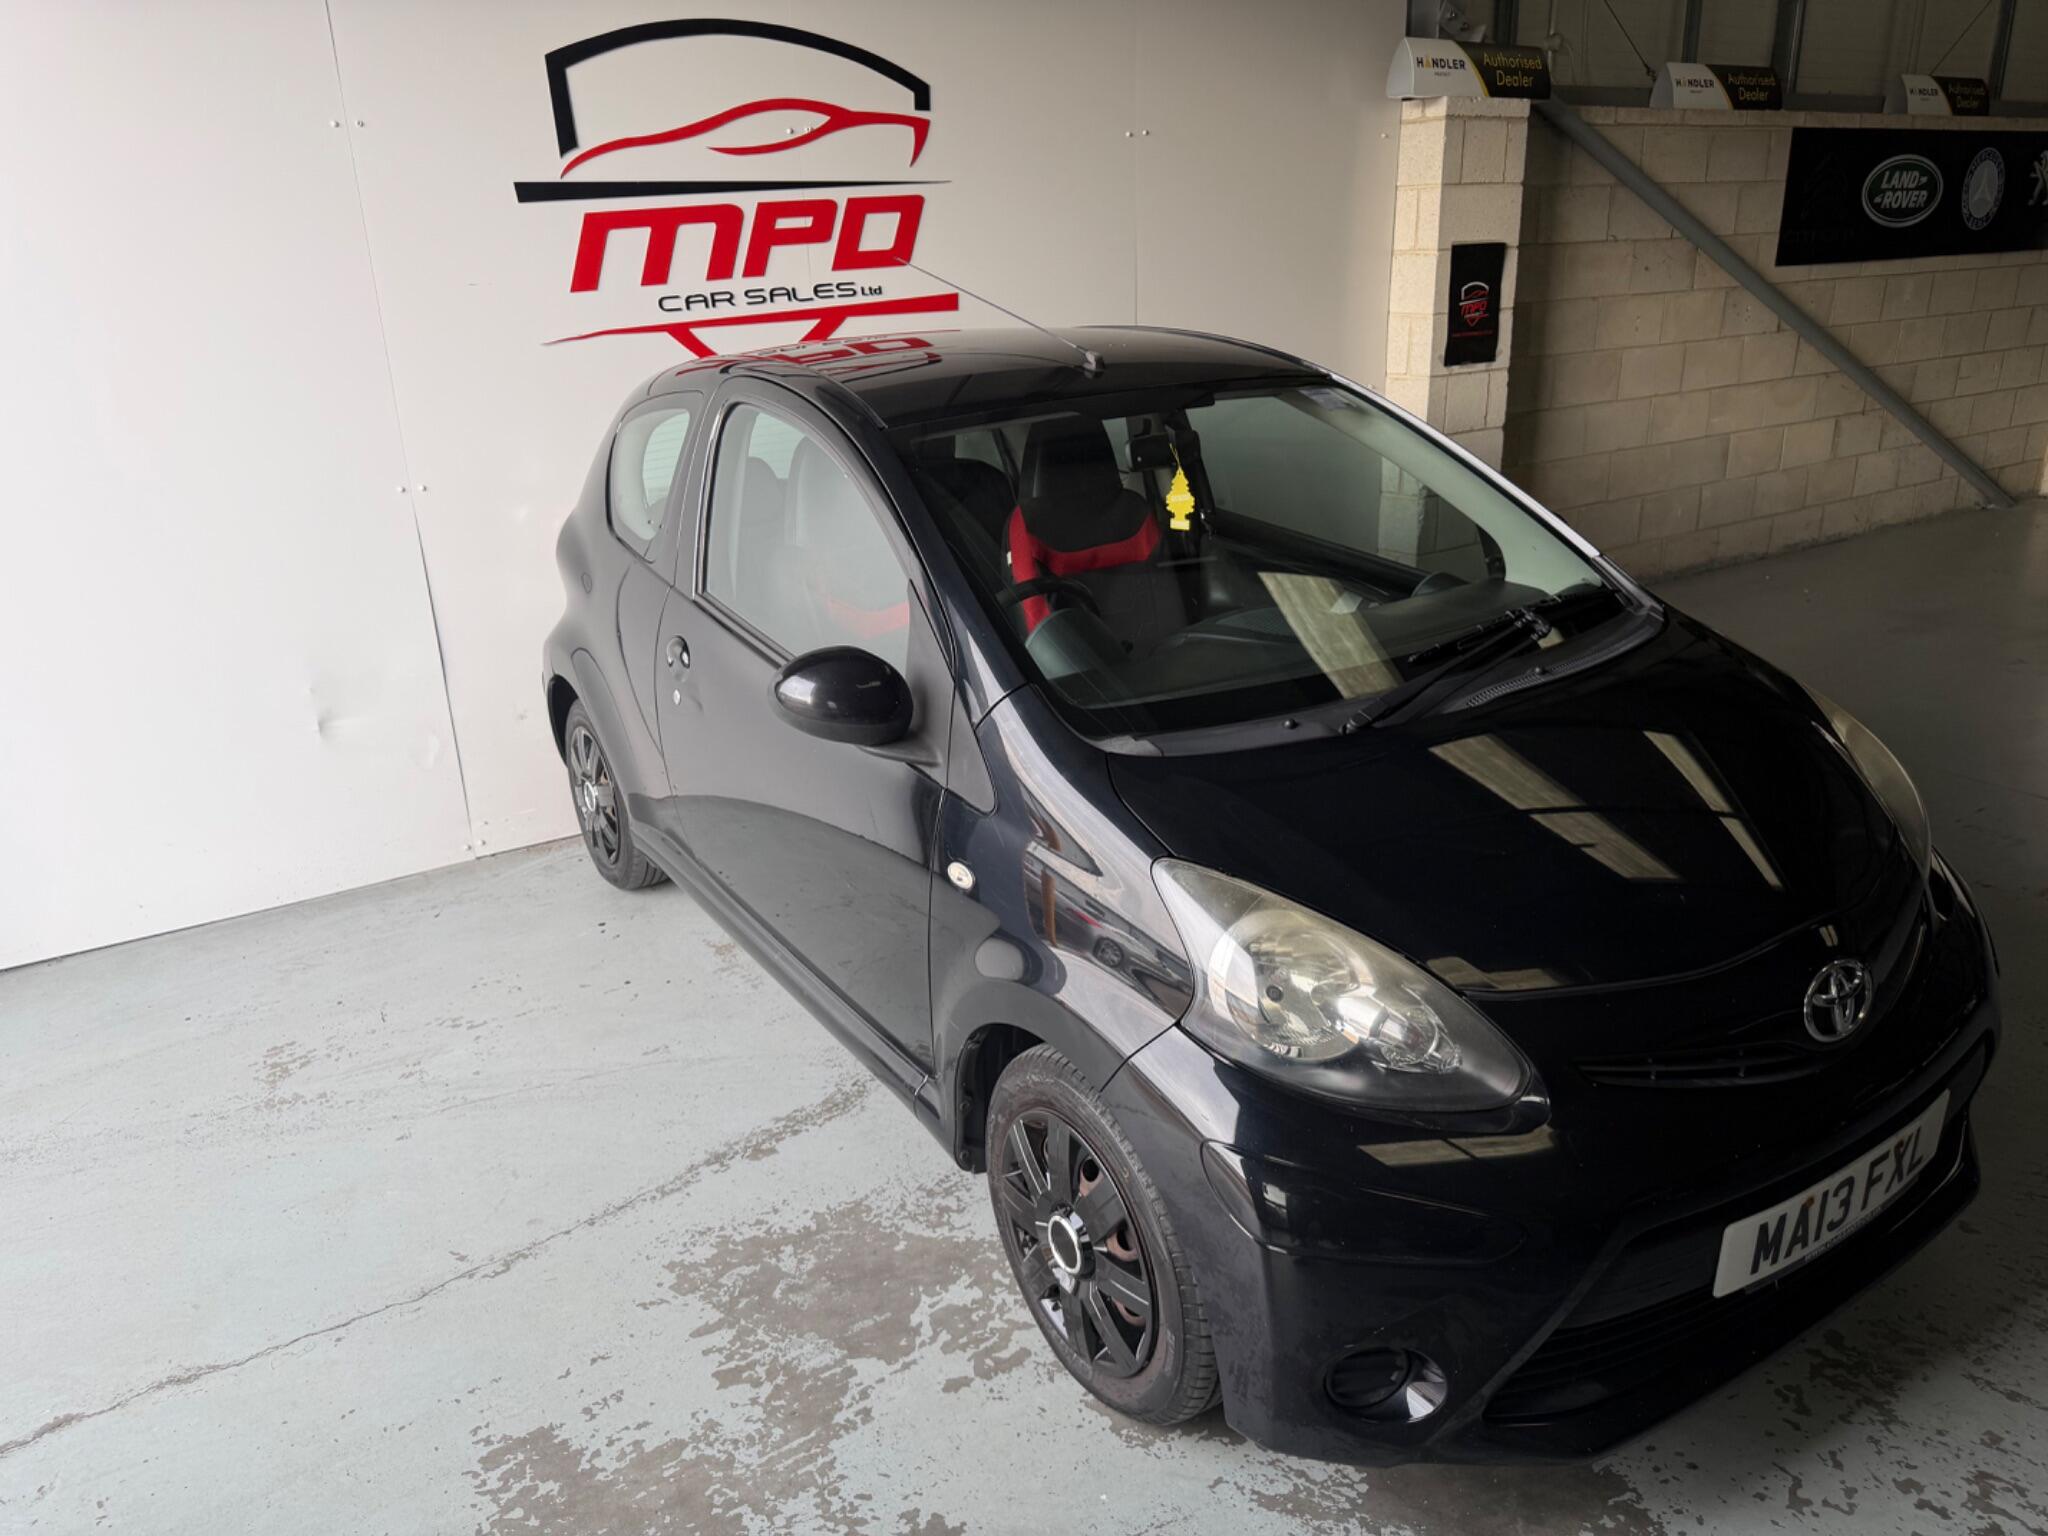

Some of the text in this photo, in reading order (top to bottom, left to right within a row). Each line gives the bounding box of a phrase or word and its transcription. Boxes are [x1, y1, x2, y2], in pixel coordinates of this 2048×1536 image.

[1483, 52, 1542, 70] Authorised
[1496, 70, 1534, 87] Dealer
[1727, 72, 1777, 86] Authorised
[1738, 87, 1768, 101] Dealer
[1880, 170, 1920, 189] LAND
[1880, 190, 1928, 209] ROVER
[658, 281, 883, 313] CAR SALES Ltd
[1750, 1176, 1855, 1275] MA13
[1861, 1127, 1924, 1212] FXL
